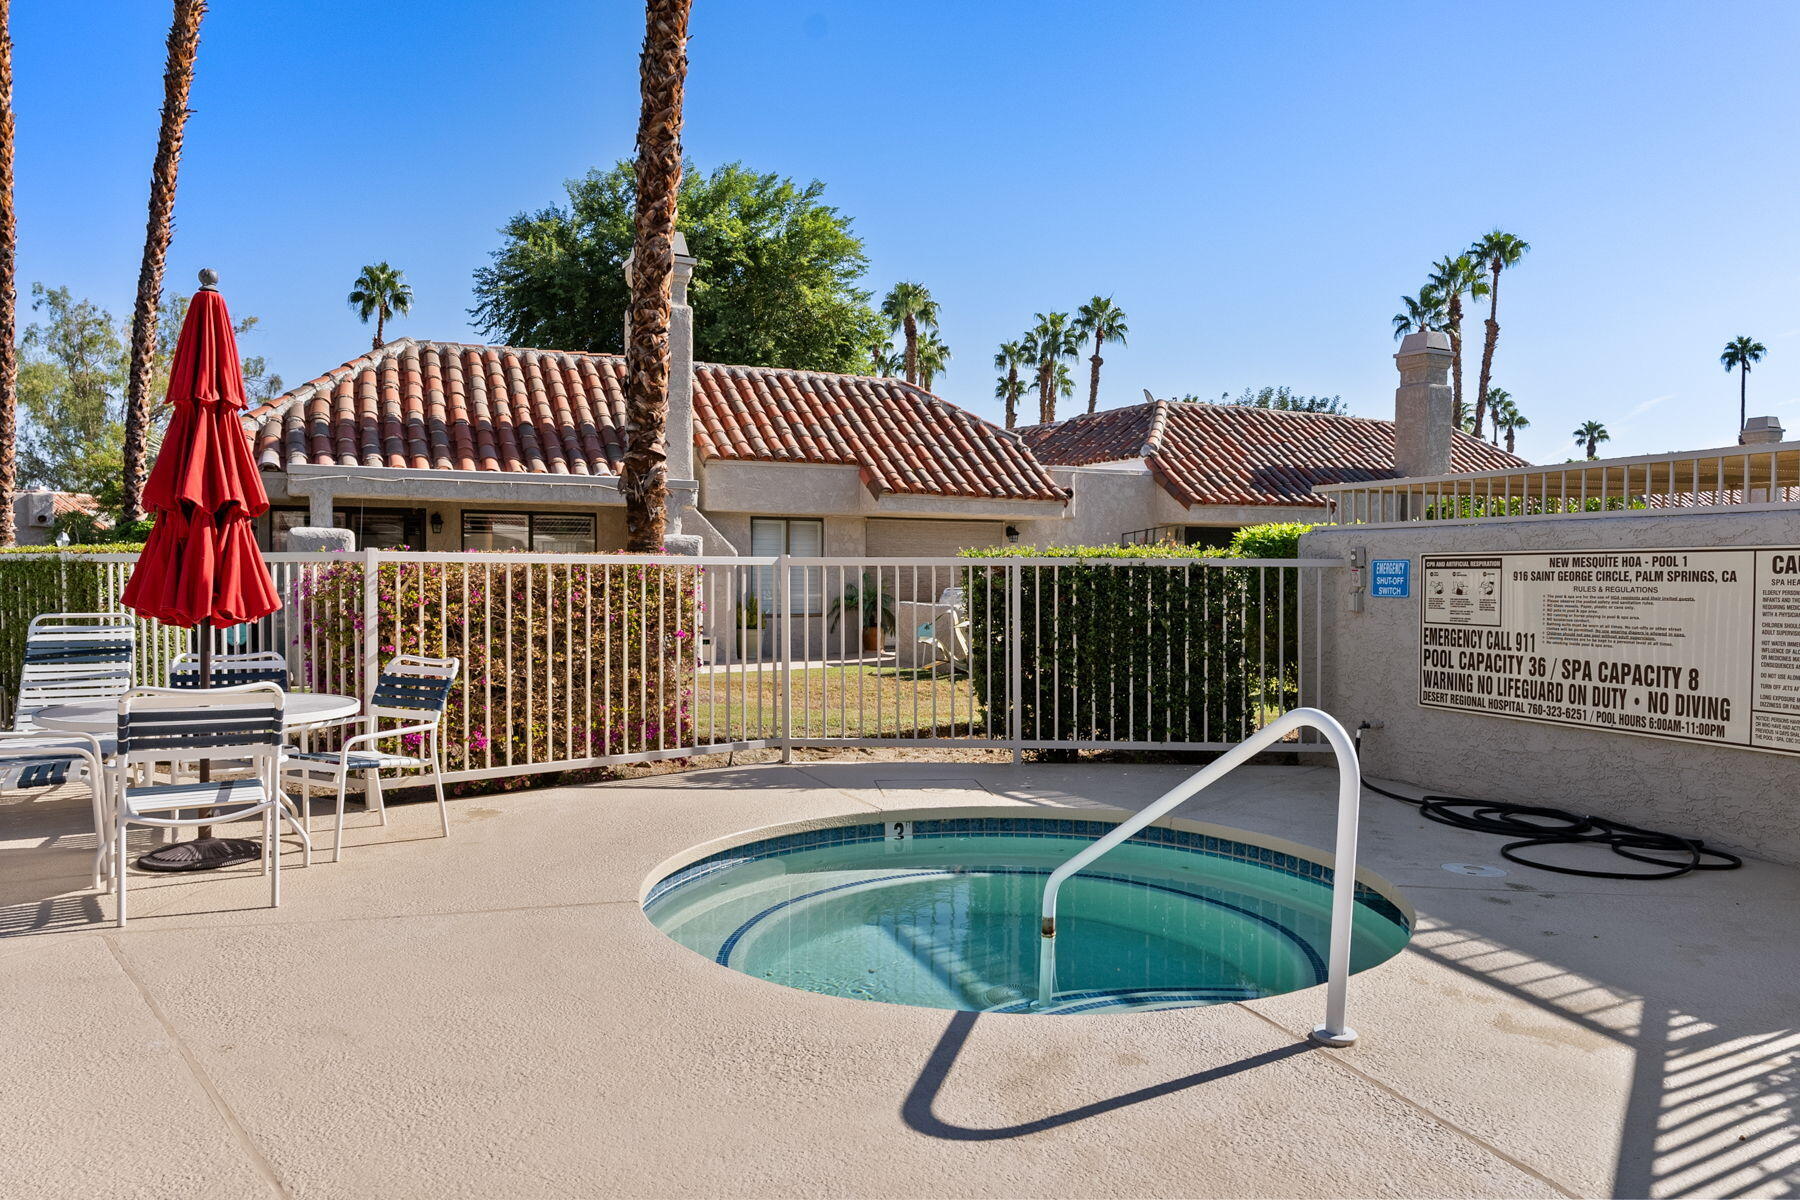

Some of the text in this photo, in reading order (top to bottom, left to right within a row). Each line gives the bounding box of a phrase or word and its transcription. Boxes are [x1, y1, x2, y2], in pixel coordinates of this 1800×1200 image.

[1549, 557, 1570, 568] NEW
[1572, 556, 1619, 569] MESQUITE
[1621, 556, 1642, 567] HOA
[1652, 555, 1679, 567] POOL
[1682, 555, 1688, 567] 1
[1772, 555, 1800, 575] CA
[1376, 577, 1405, 585] SHUT-OFF
[1513, 570, 1738, 584] 916 SAINT GEORGE CIRCLE, PALM SPRINGS, CA
[1378, 587, 1401, 595] SWITCH
[1423, 627, 1483, 649] EMERGENCY
[1486, 631, 1512, 651] CALL
[1516, 632, 1535, 653] 911
[1423, 649, 1700, 691] POOL CAPACITY 36 / SPA CAPACITY 8
[1423, 669, 1731, 722] WARNING NO LIFEGUARD ON DUTY NO DIVING
[1423, 690, 1725, 738] DESERT REGIONAL HOSPITAL 760-323-6251 / POOL HOURS 6:00AM-11:00PM
[894, 822, 904, 840] 3
